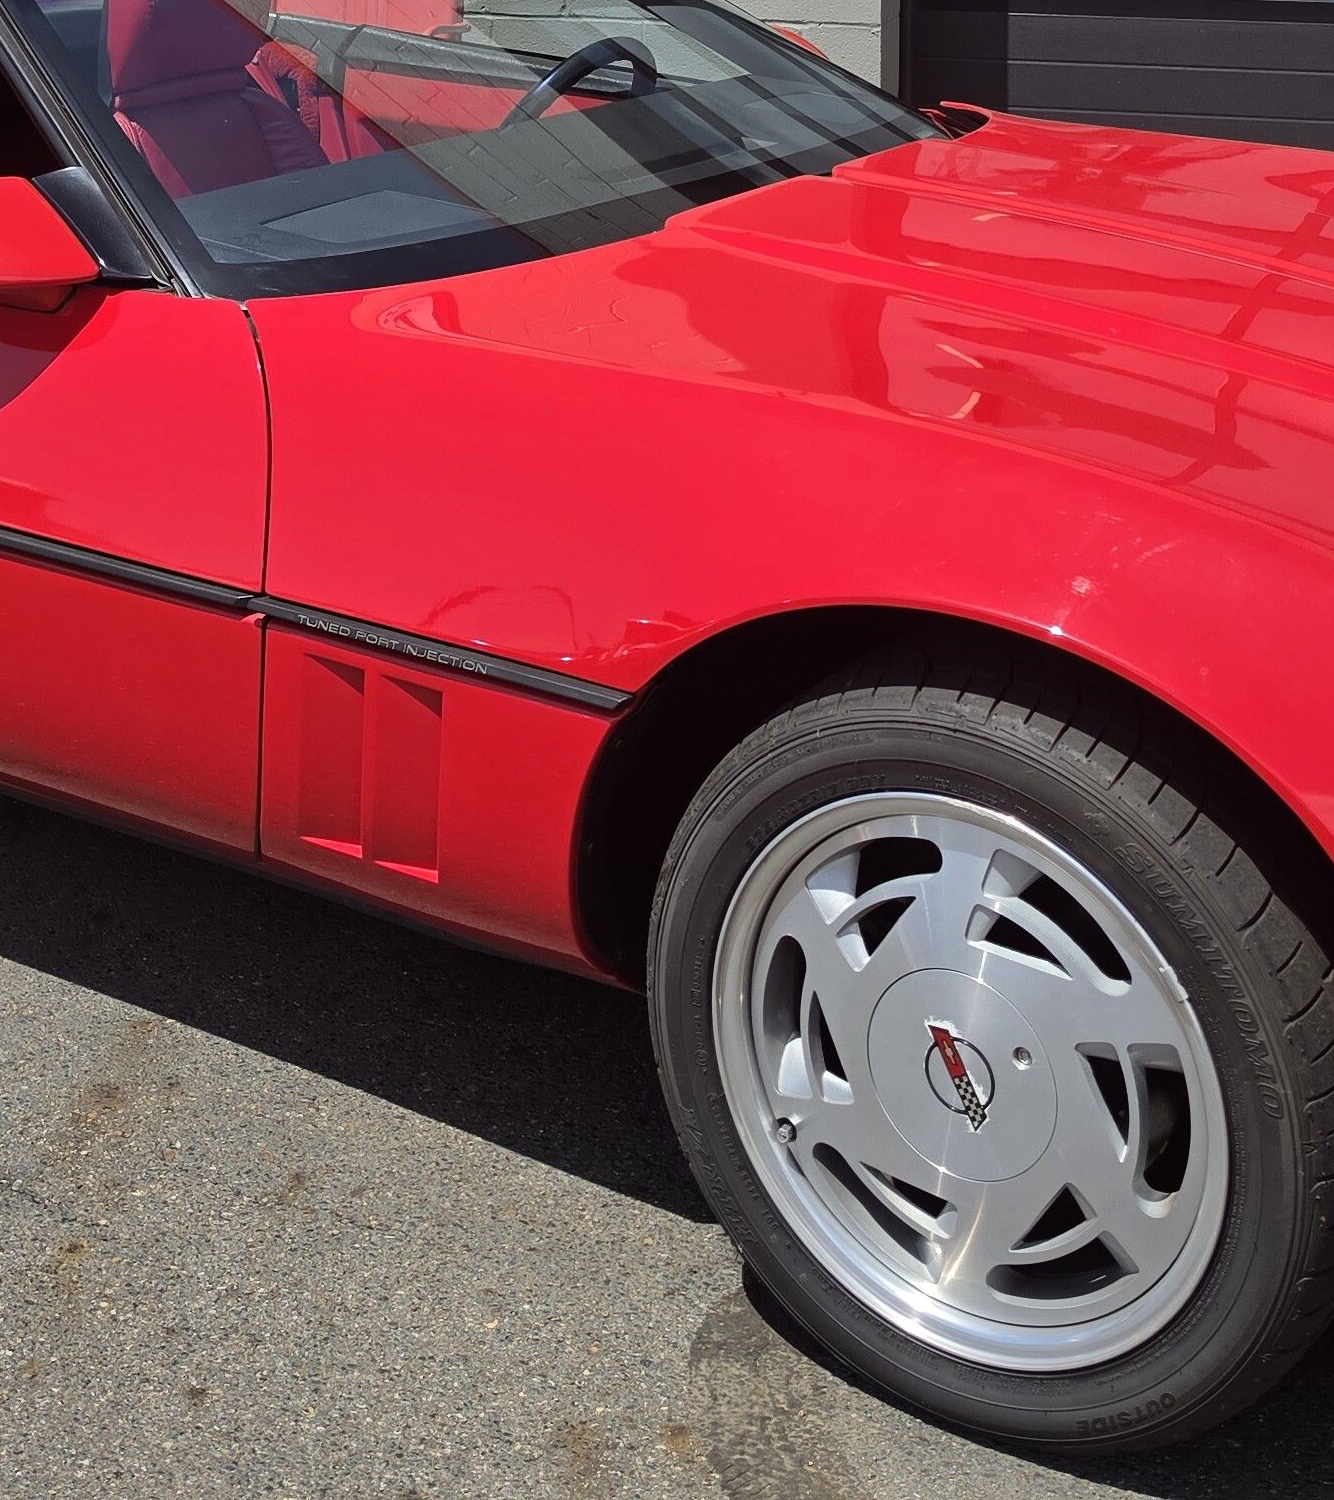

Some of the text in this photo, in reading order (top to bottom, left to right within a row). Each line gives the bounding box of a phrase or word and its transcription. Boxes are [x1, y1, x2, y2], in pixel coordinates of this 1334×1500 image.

[297, 613, 489, 676] TUNED PORT INJECTION
[1115, 842, 1285, 1121] SUMITOMO
